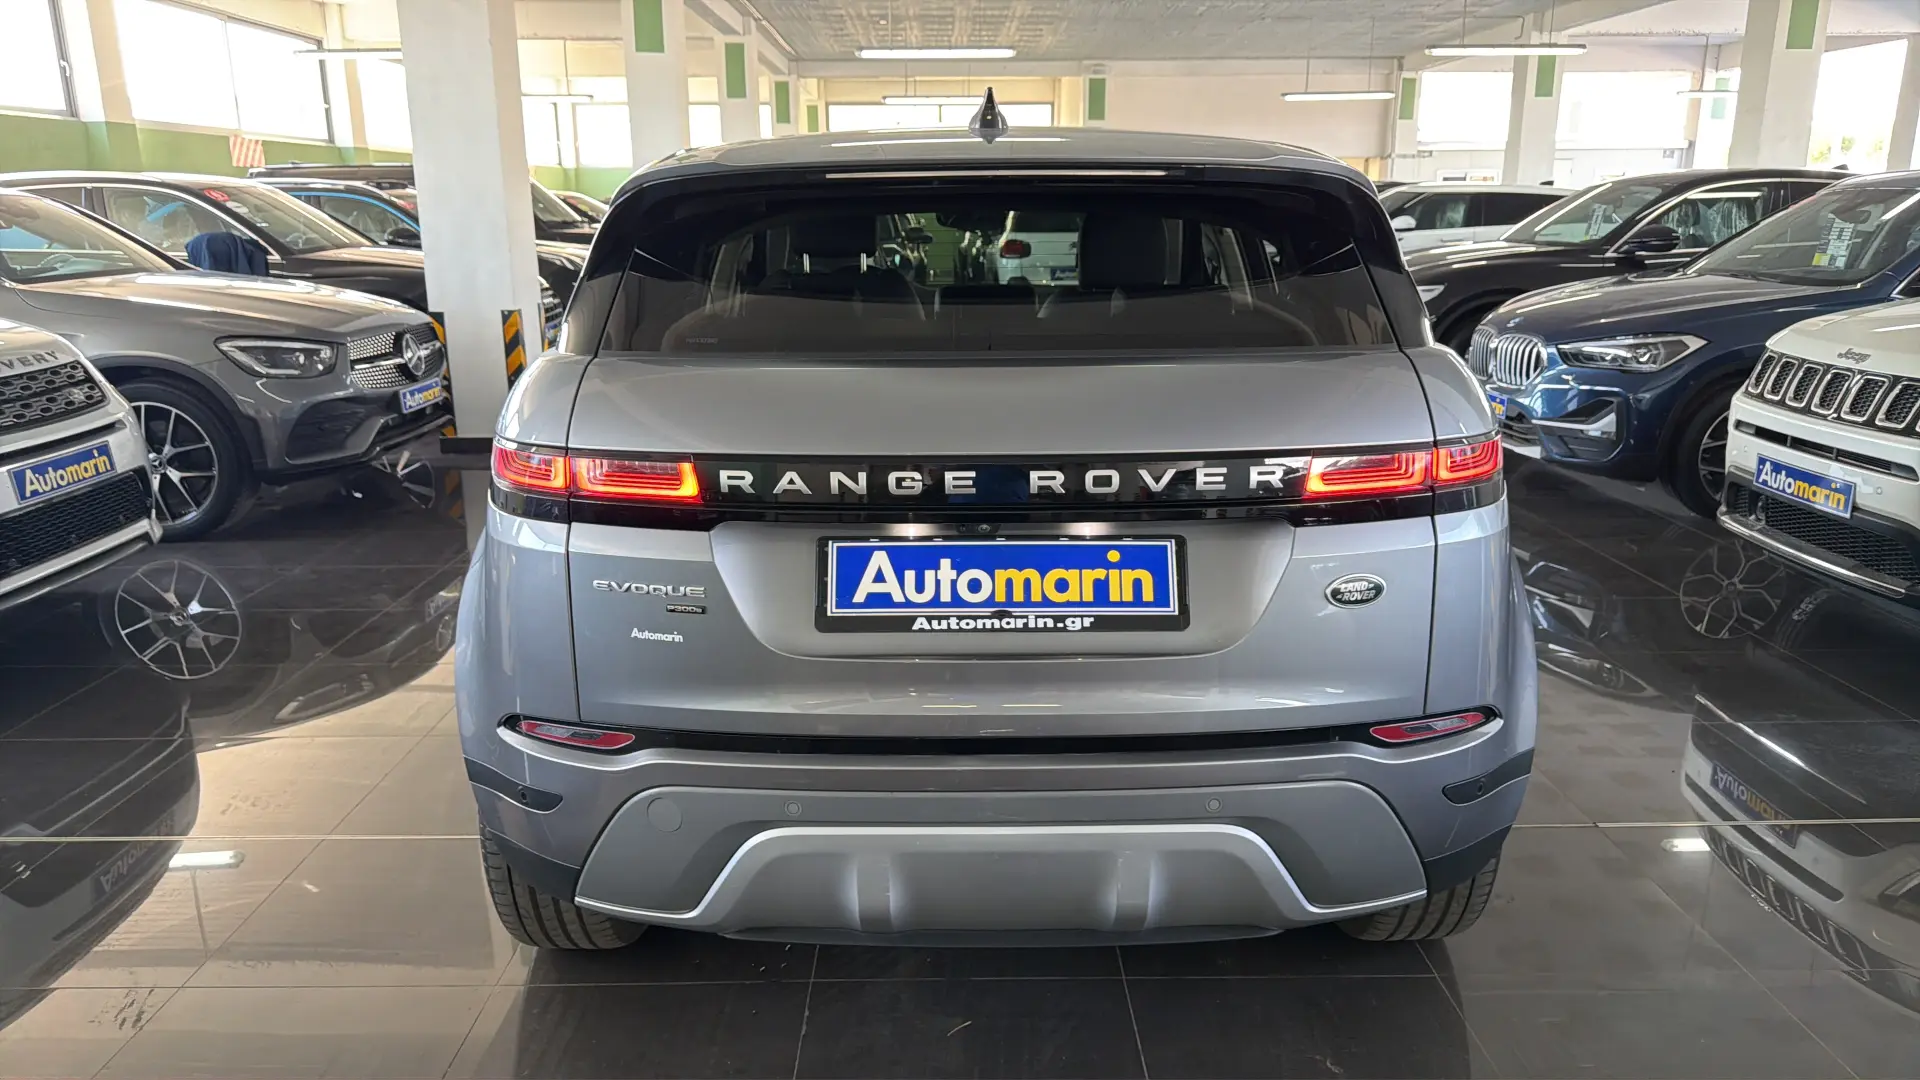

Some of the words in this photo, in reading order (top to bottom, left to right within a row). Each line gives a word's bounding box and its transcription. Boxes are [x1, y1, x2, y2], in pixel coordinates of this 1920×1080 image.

[1836, 347, 1872, 364] Jeep
[25, 449, 111, 498] Automarin
[719, 469, 977, 496] RANGE
[1029, 465, 1284, 494] ROVER
[1758, 460, 1846, 511] Automarin
[851, 549, 1155, 603] Automarin
[592, 579, 706, 599] EVOQUE
[1340, 580, 1369, 592] LAND
[1341, 589, 1377, 601] ROVER
[911, 614, 1095, 632] Automarin.gr
[630, 627, 684, 643] Automarin
